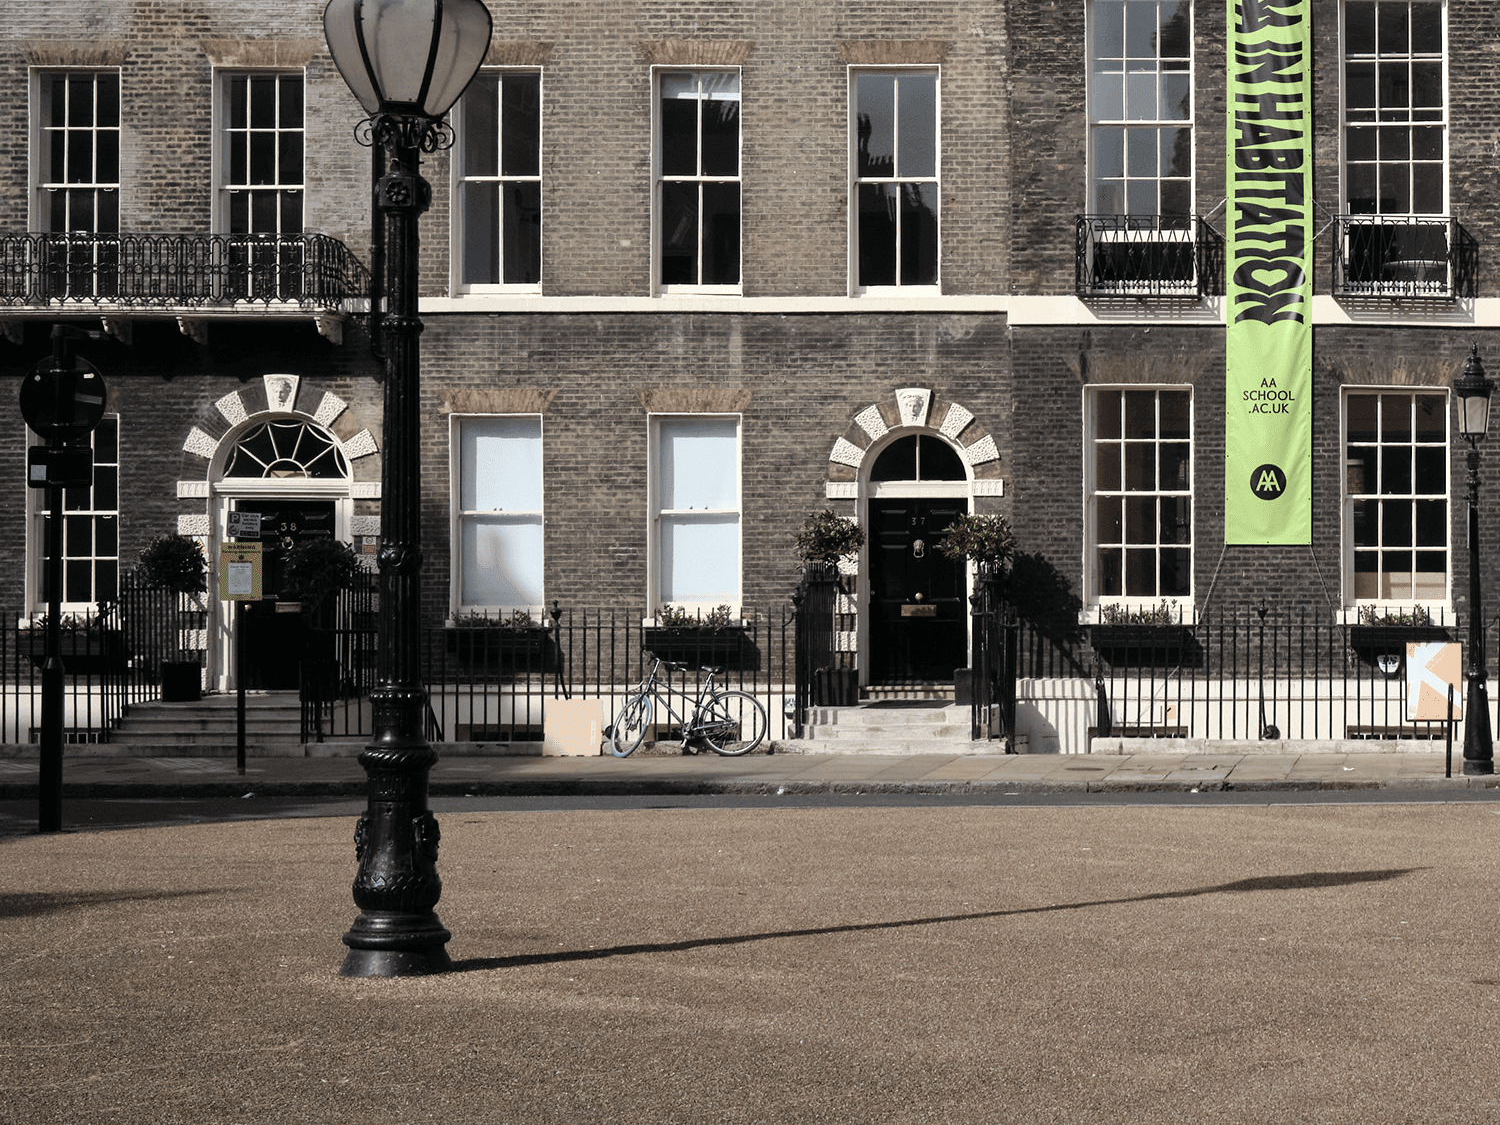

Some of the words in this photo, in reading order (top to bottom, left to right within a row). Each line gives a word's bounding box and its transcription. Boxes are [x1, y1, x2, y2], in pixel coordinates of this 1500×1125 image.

[1260, 378, 1277, 388] AA
[1243, 390, 1295, 401] SCHOOL
[1248, 403, 1289, 414] .AC.UK
[1255, 469, 1281, 492] AA
[911, 517, 926, 525] 37
[280, 522, 297, 531] 38
